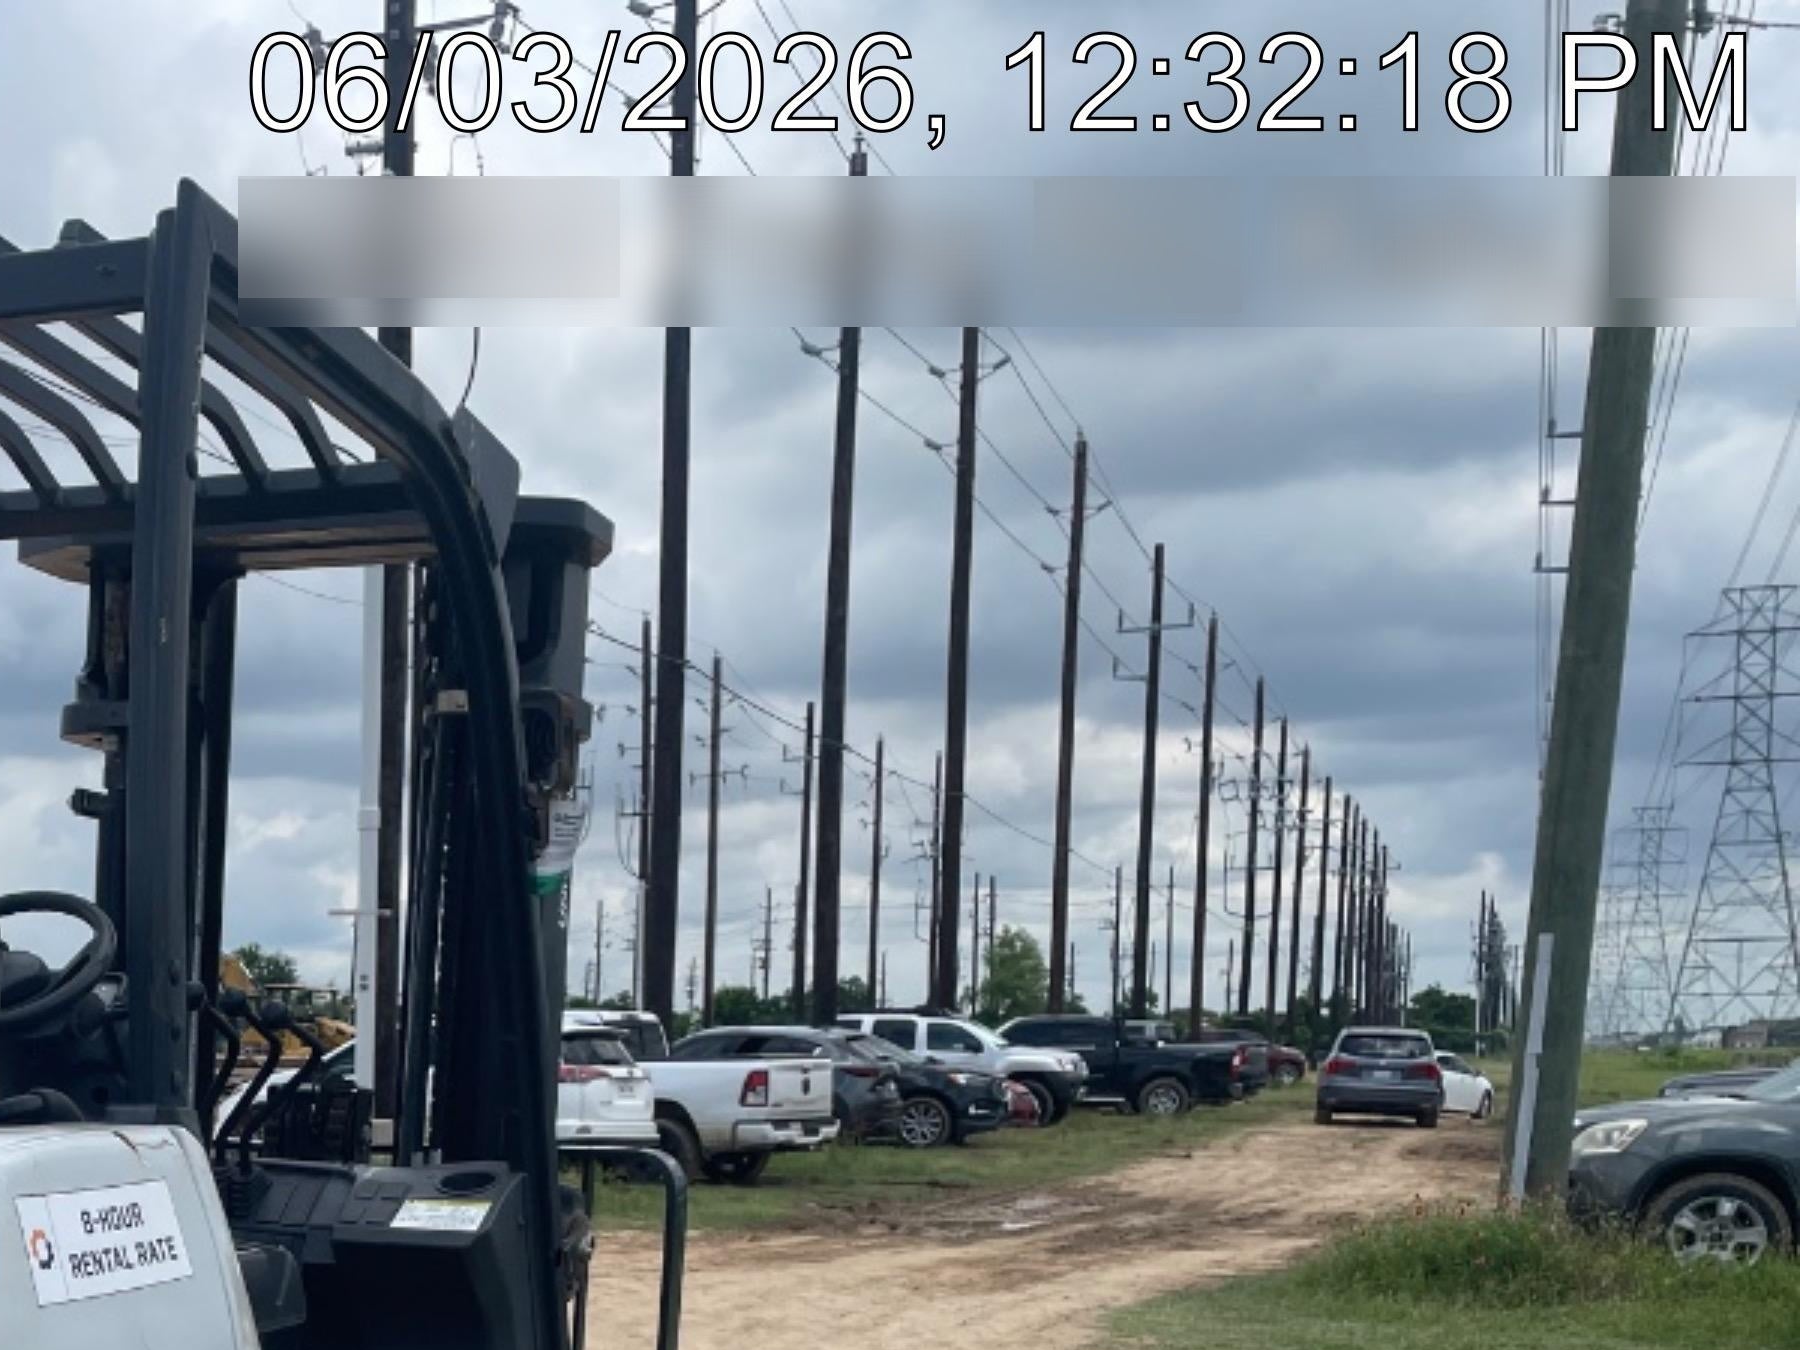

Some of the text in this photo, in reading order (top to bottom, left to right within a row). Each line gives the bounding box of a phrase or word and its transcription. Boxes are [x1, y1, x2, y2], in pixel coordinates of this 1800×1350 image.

[80, 1202, 145, 1235] 8-HOUR
[69, 1236, 178, 1278] RENTAL RATE
